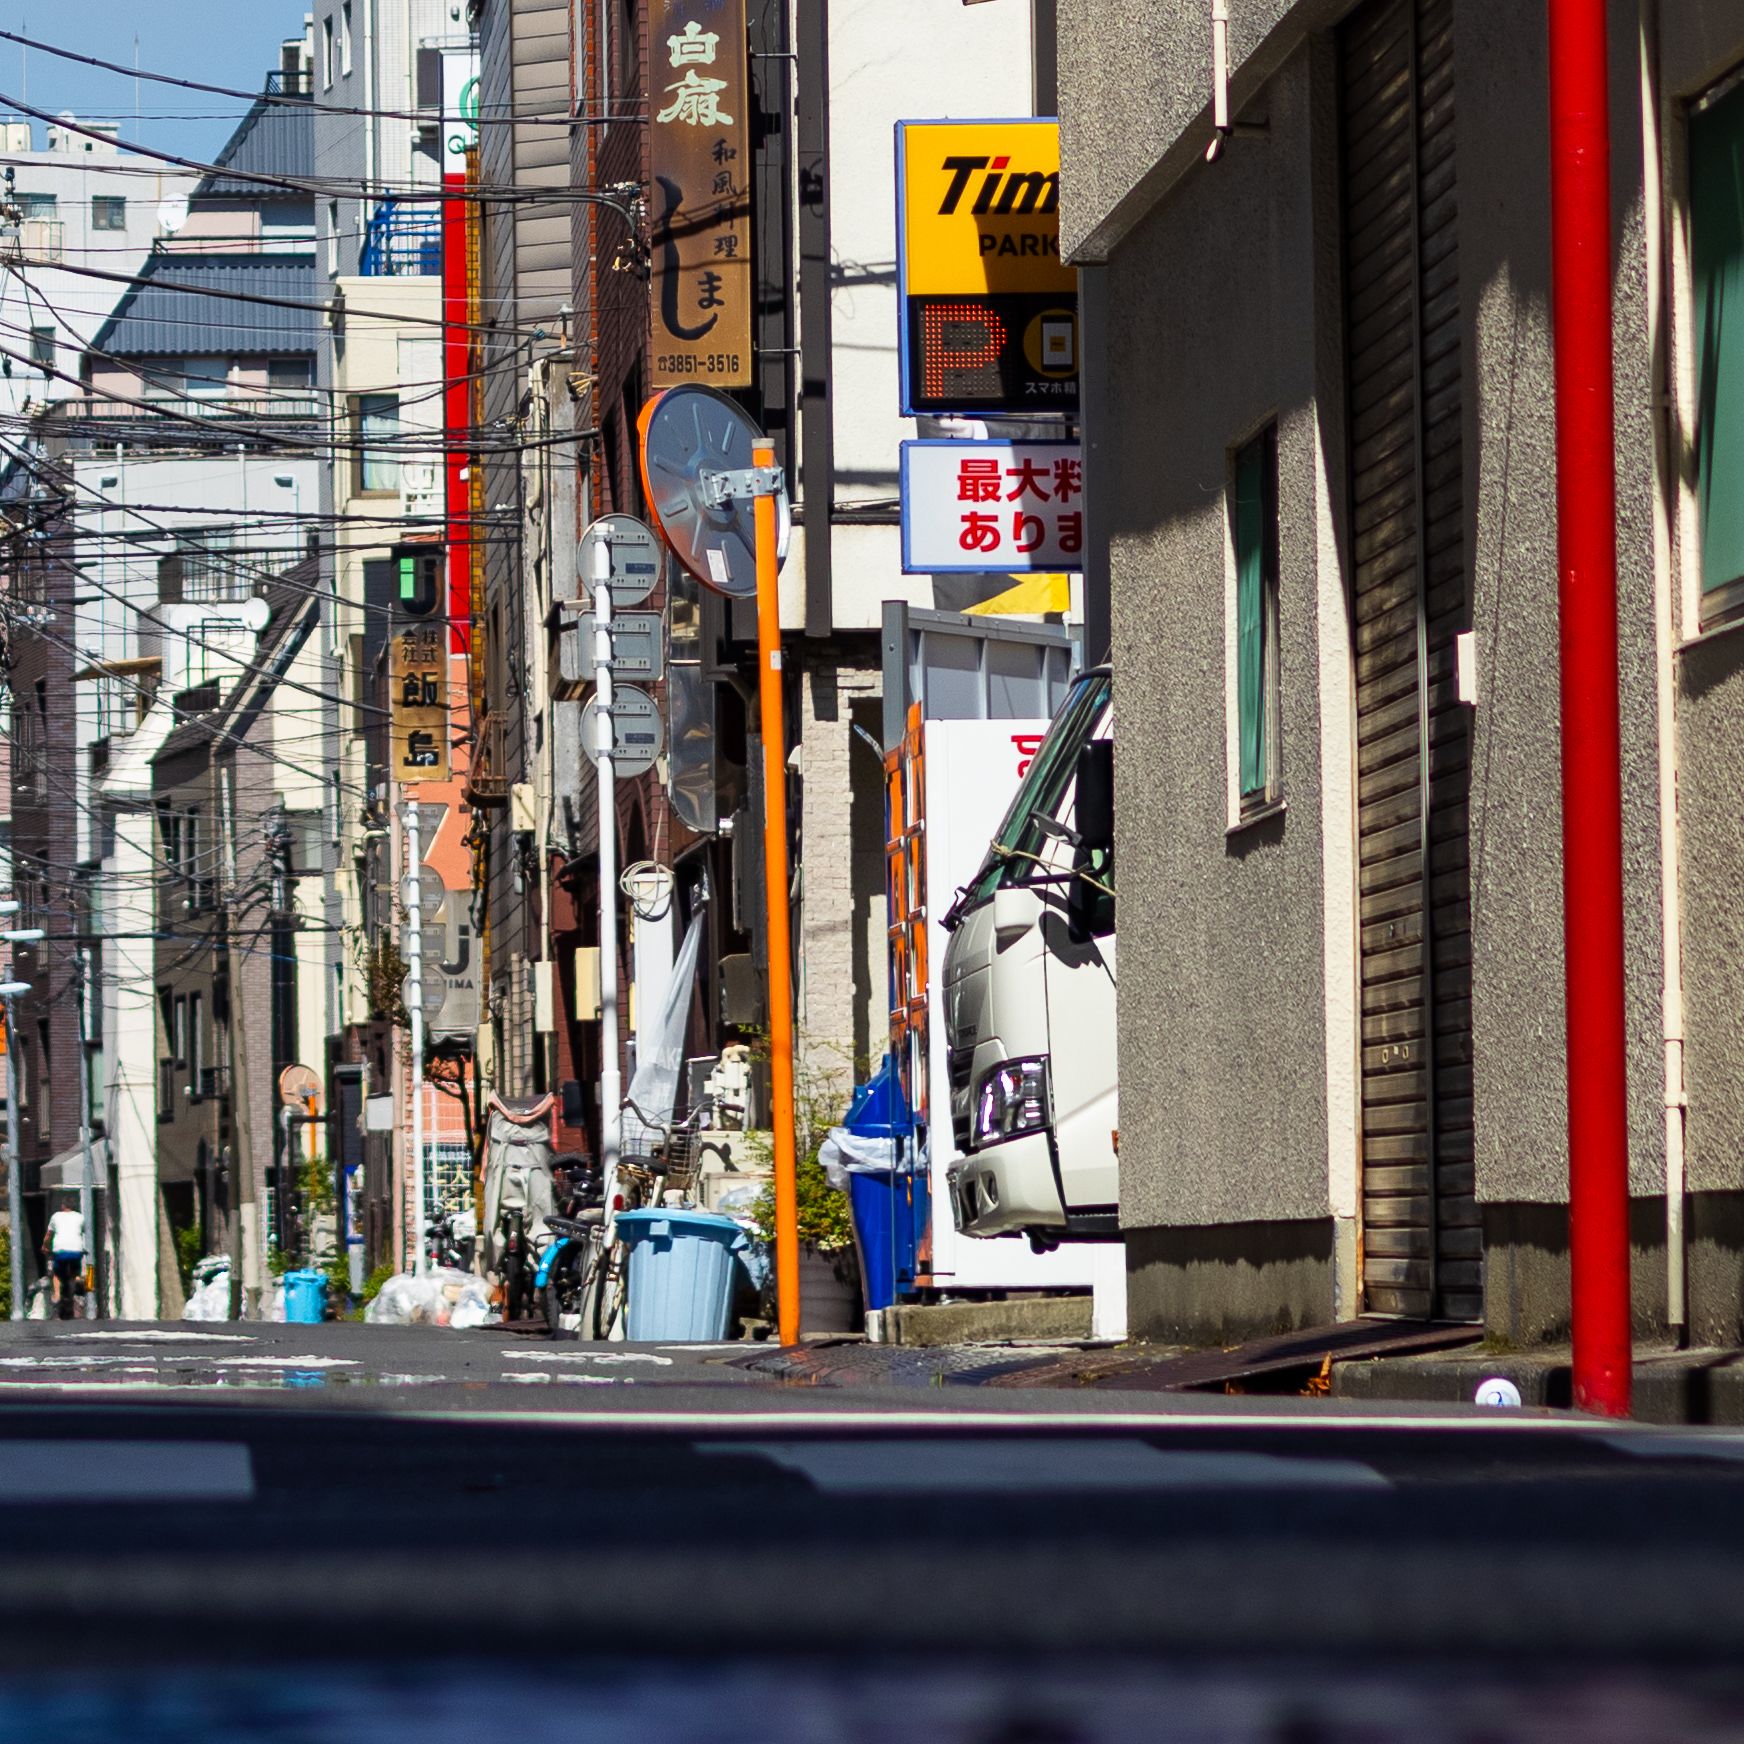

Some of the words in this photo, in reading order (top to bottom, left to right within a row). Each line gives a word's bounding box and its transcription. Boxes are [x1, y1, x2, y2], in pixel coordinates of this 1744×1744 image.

[656, 20, 734, 127] 白扇
[924, 303, 1008, 398] P
[958, 510, 1083, 553] ありま
